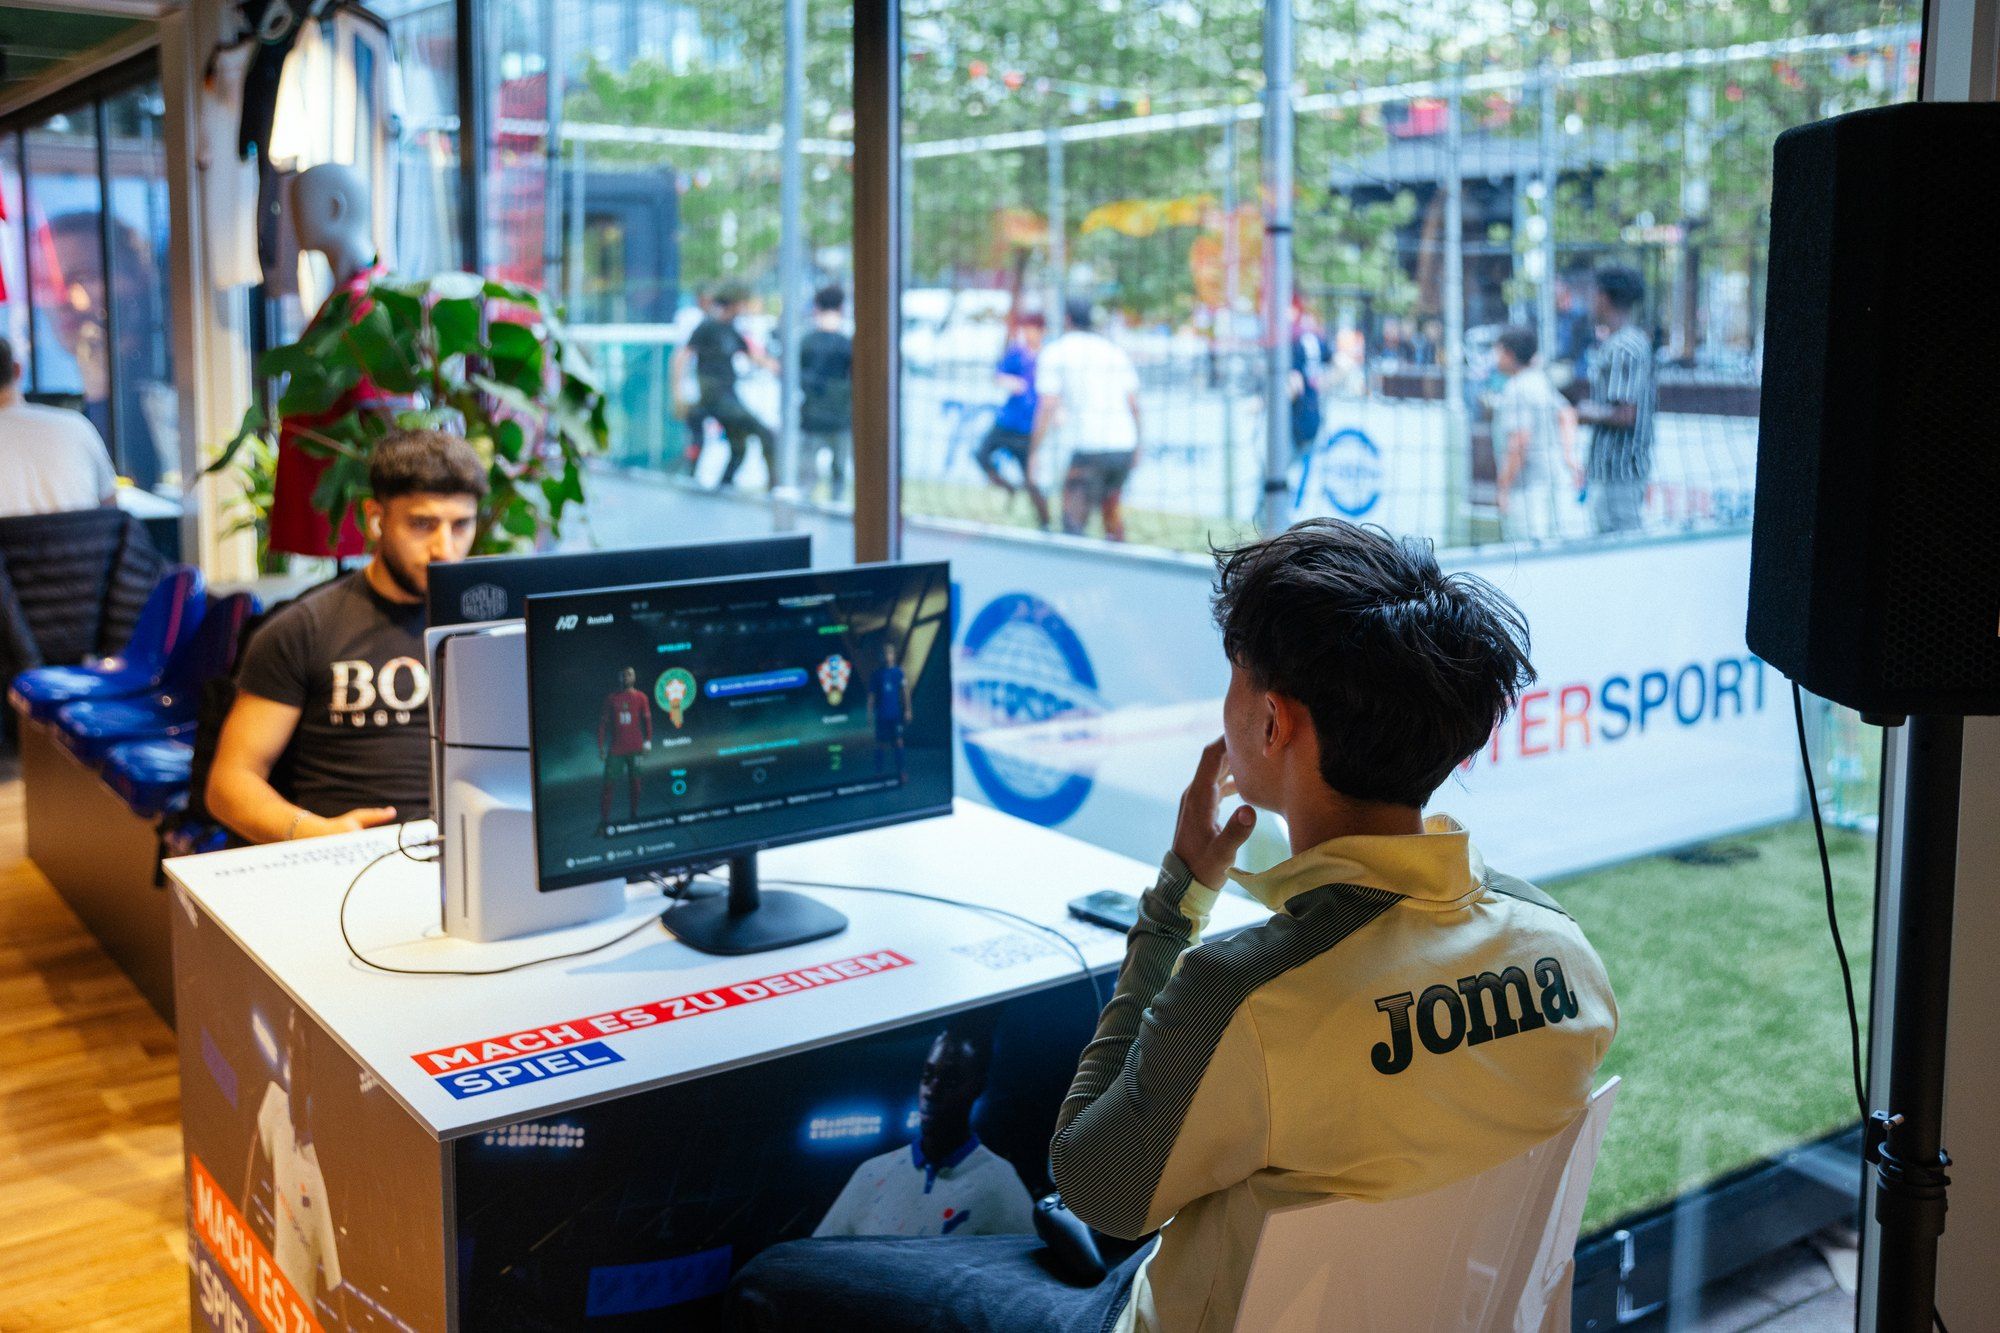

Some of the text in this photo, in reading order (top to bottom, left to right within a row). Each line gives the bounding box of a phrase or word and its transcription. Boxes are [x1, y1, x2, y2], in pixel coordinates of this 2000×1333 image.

[329, 656, 430, 712] BO
[427, 951, 901, 1071] MACH ES ZU DEINEM
[454, 1050, 611, 1093] SPIEL
[196, 1173, 254, 1295] MACH
